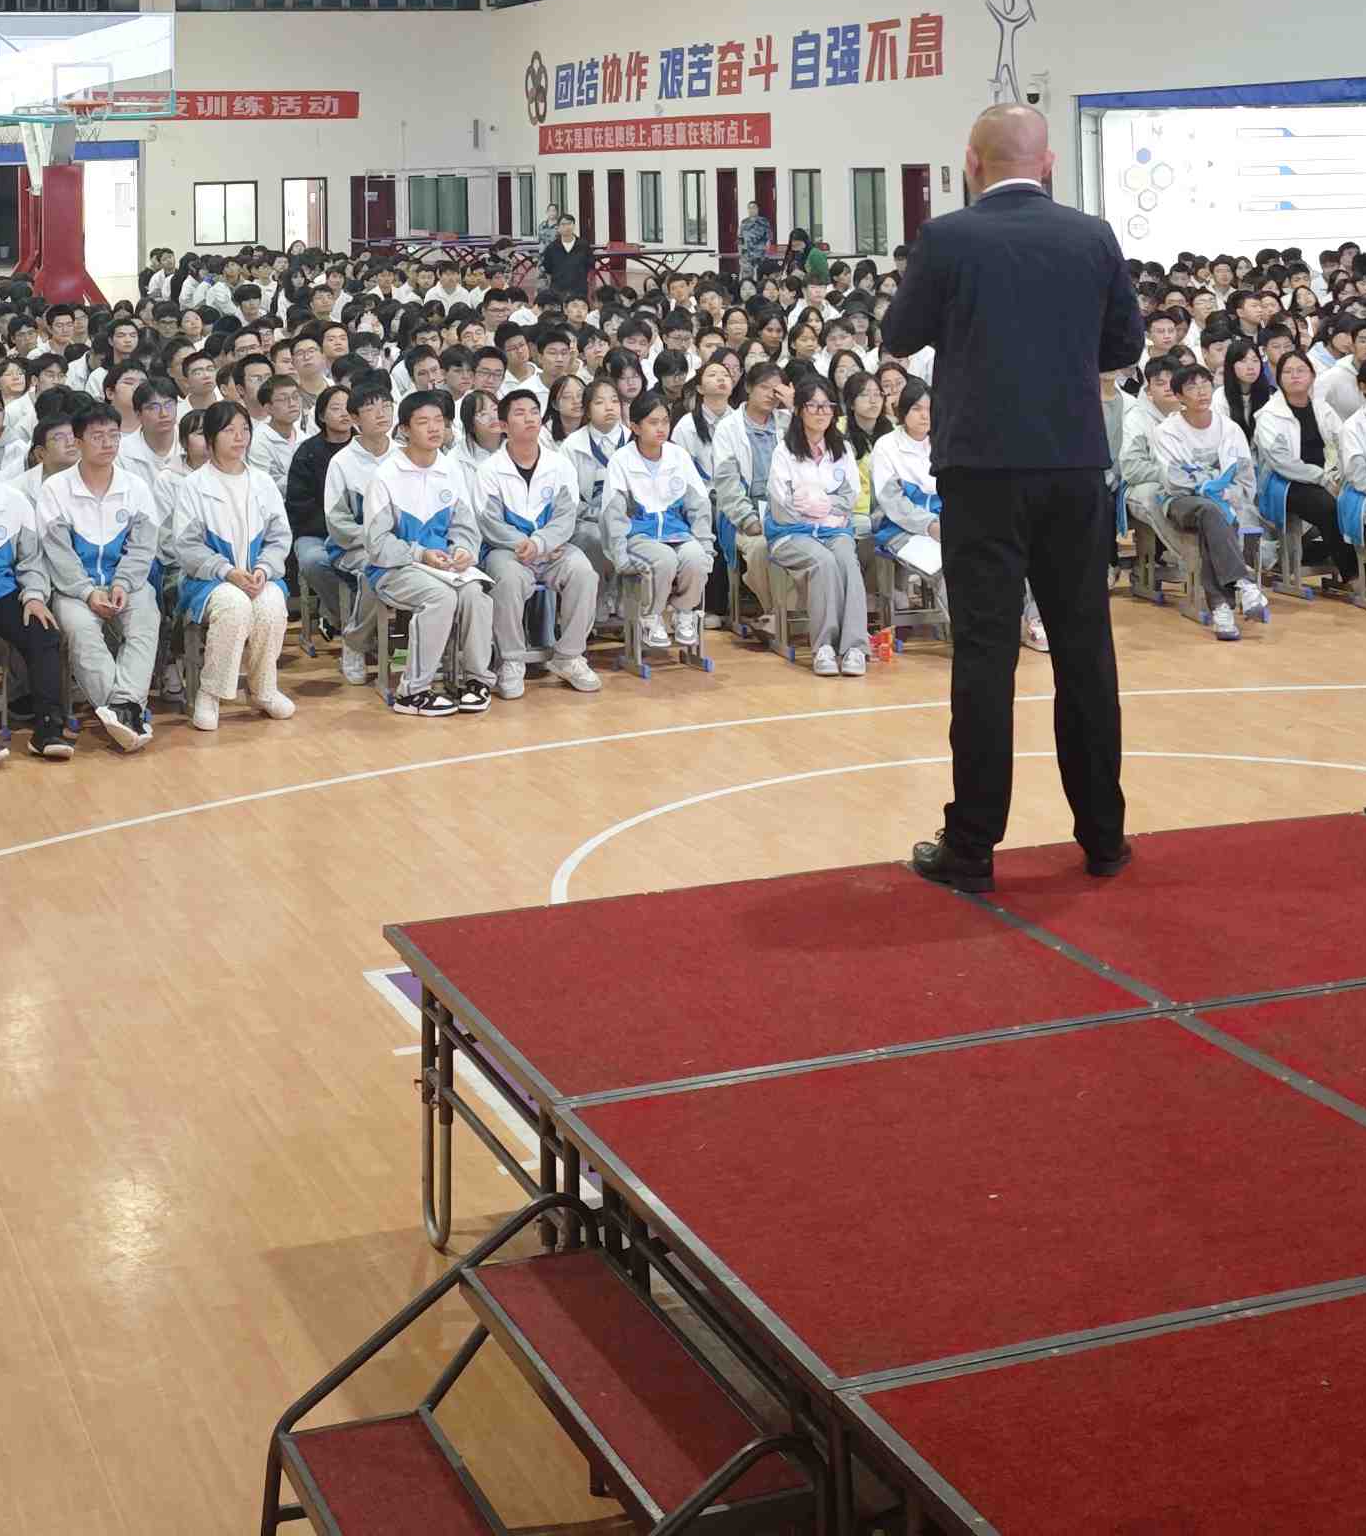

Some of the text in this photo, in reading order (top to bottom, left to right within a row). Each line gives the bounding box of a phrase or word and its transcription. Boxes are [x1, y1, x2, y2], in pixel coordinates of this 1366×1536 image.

[554, 13, 944, 110] 团结协作 艰苦奋斗 自强不息
